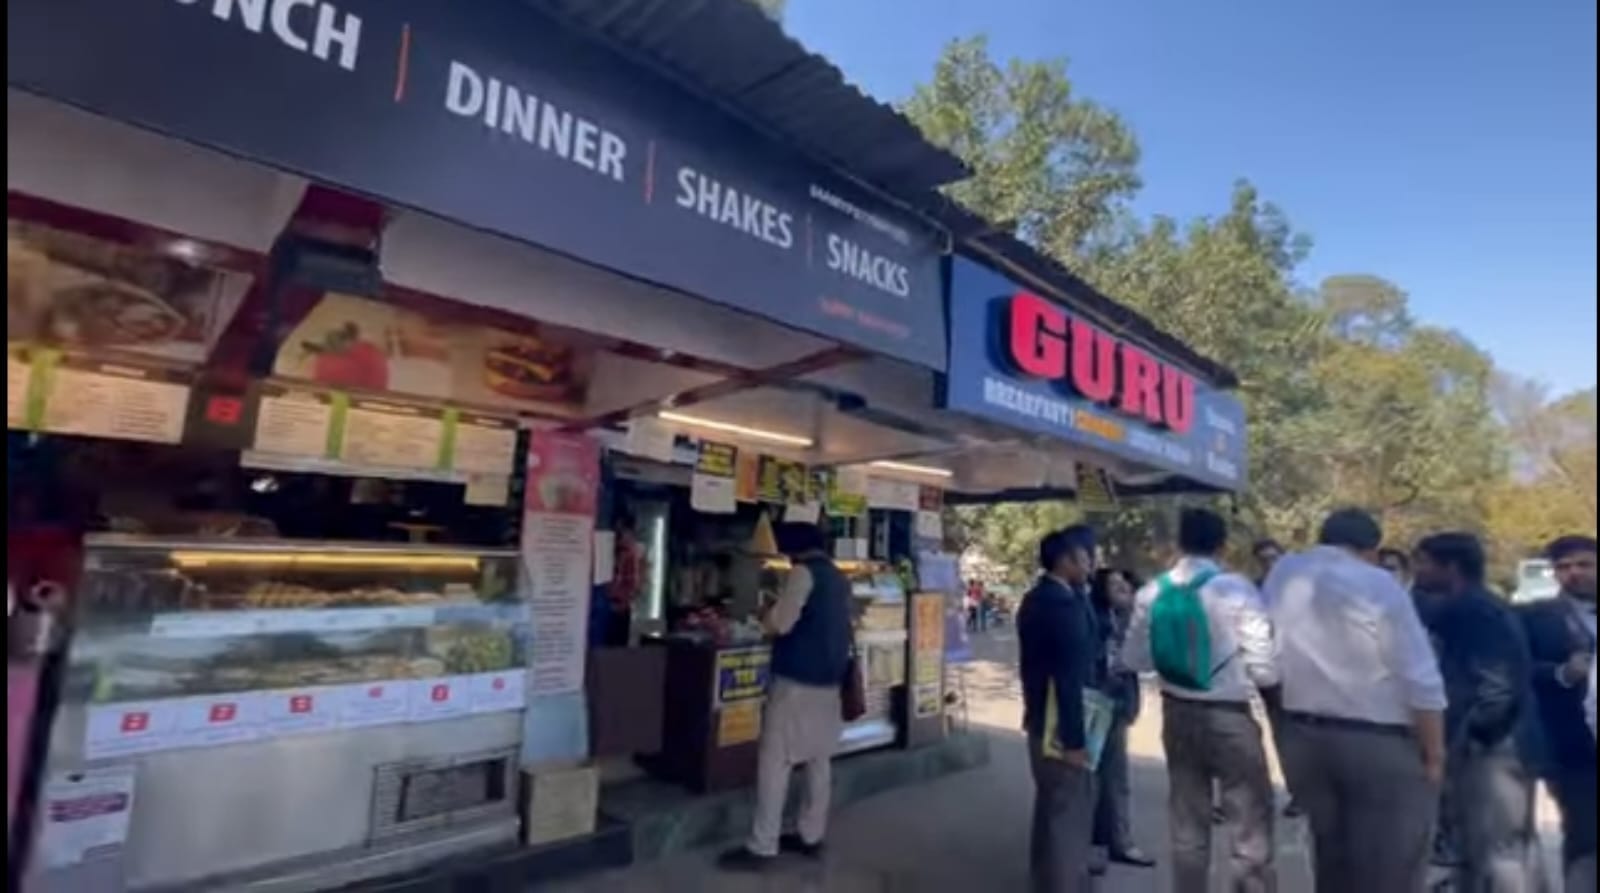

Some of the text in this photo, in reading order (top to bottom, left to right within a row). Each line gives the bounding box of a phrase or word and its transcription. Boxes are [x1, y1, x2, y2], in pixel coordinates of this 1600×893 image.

[445, 60, 627, 182] DINNER
[676, 167, 793, 248] SHAKES
[827, 233, 909, 297] SNACKS
[1010, 288, 1196, 434] GURU
